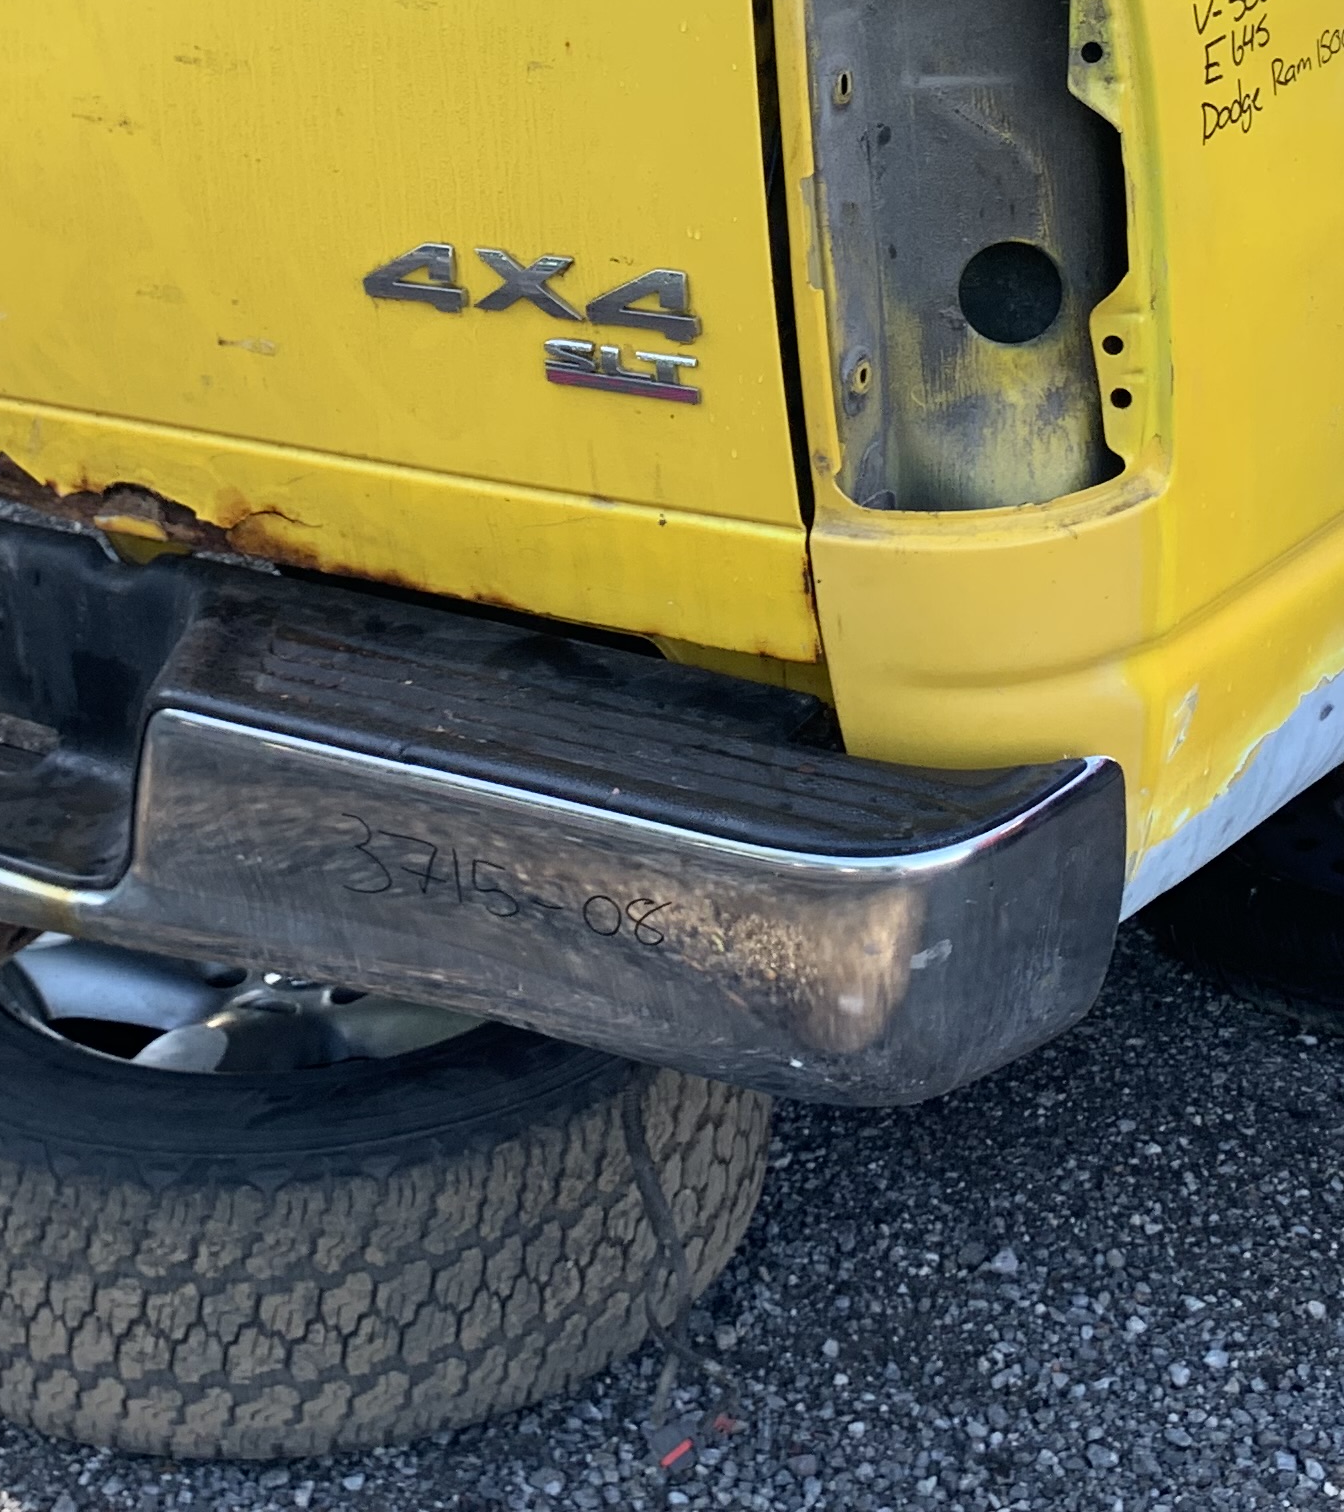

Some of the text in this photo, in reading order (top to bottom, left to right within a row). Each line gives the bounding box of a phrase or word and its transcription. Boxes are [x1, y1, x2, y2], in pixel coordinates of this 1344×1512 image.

[1201, 78, 1264, 146] Dodge
[1270, 57, 1313, 96] Ram
[543, 337, 700, 387] SLT
[341, 812, 673, 946] 3715-08
